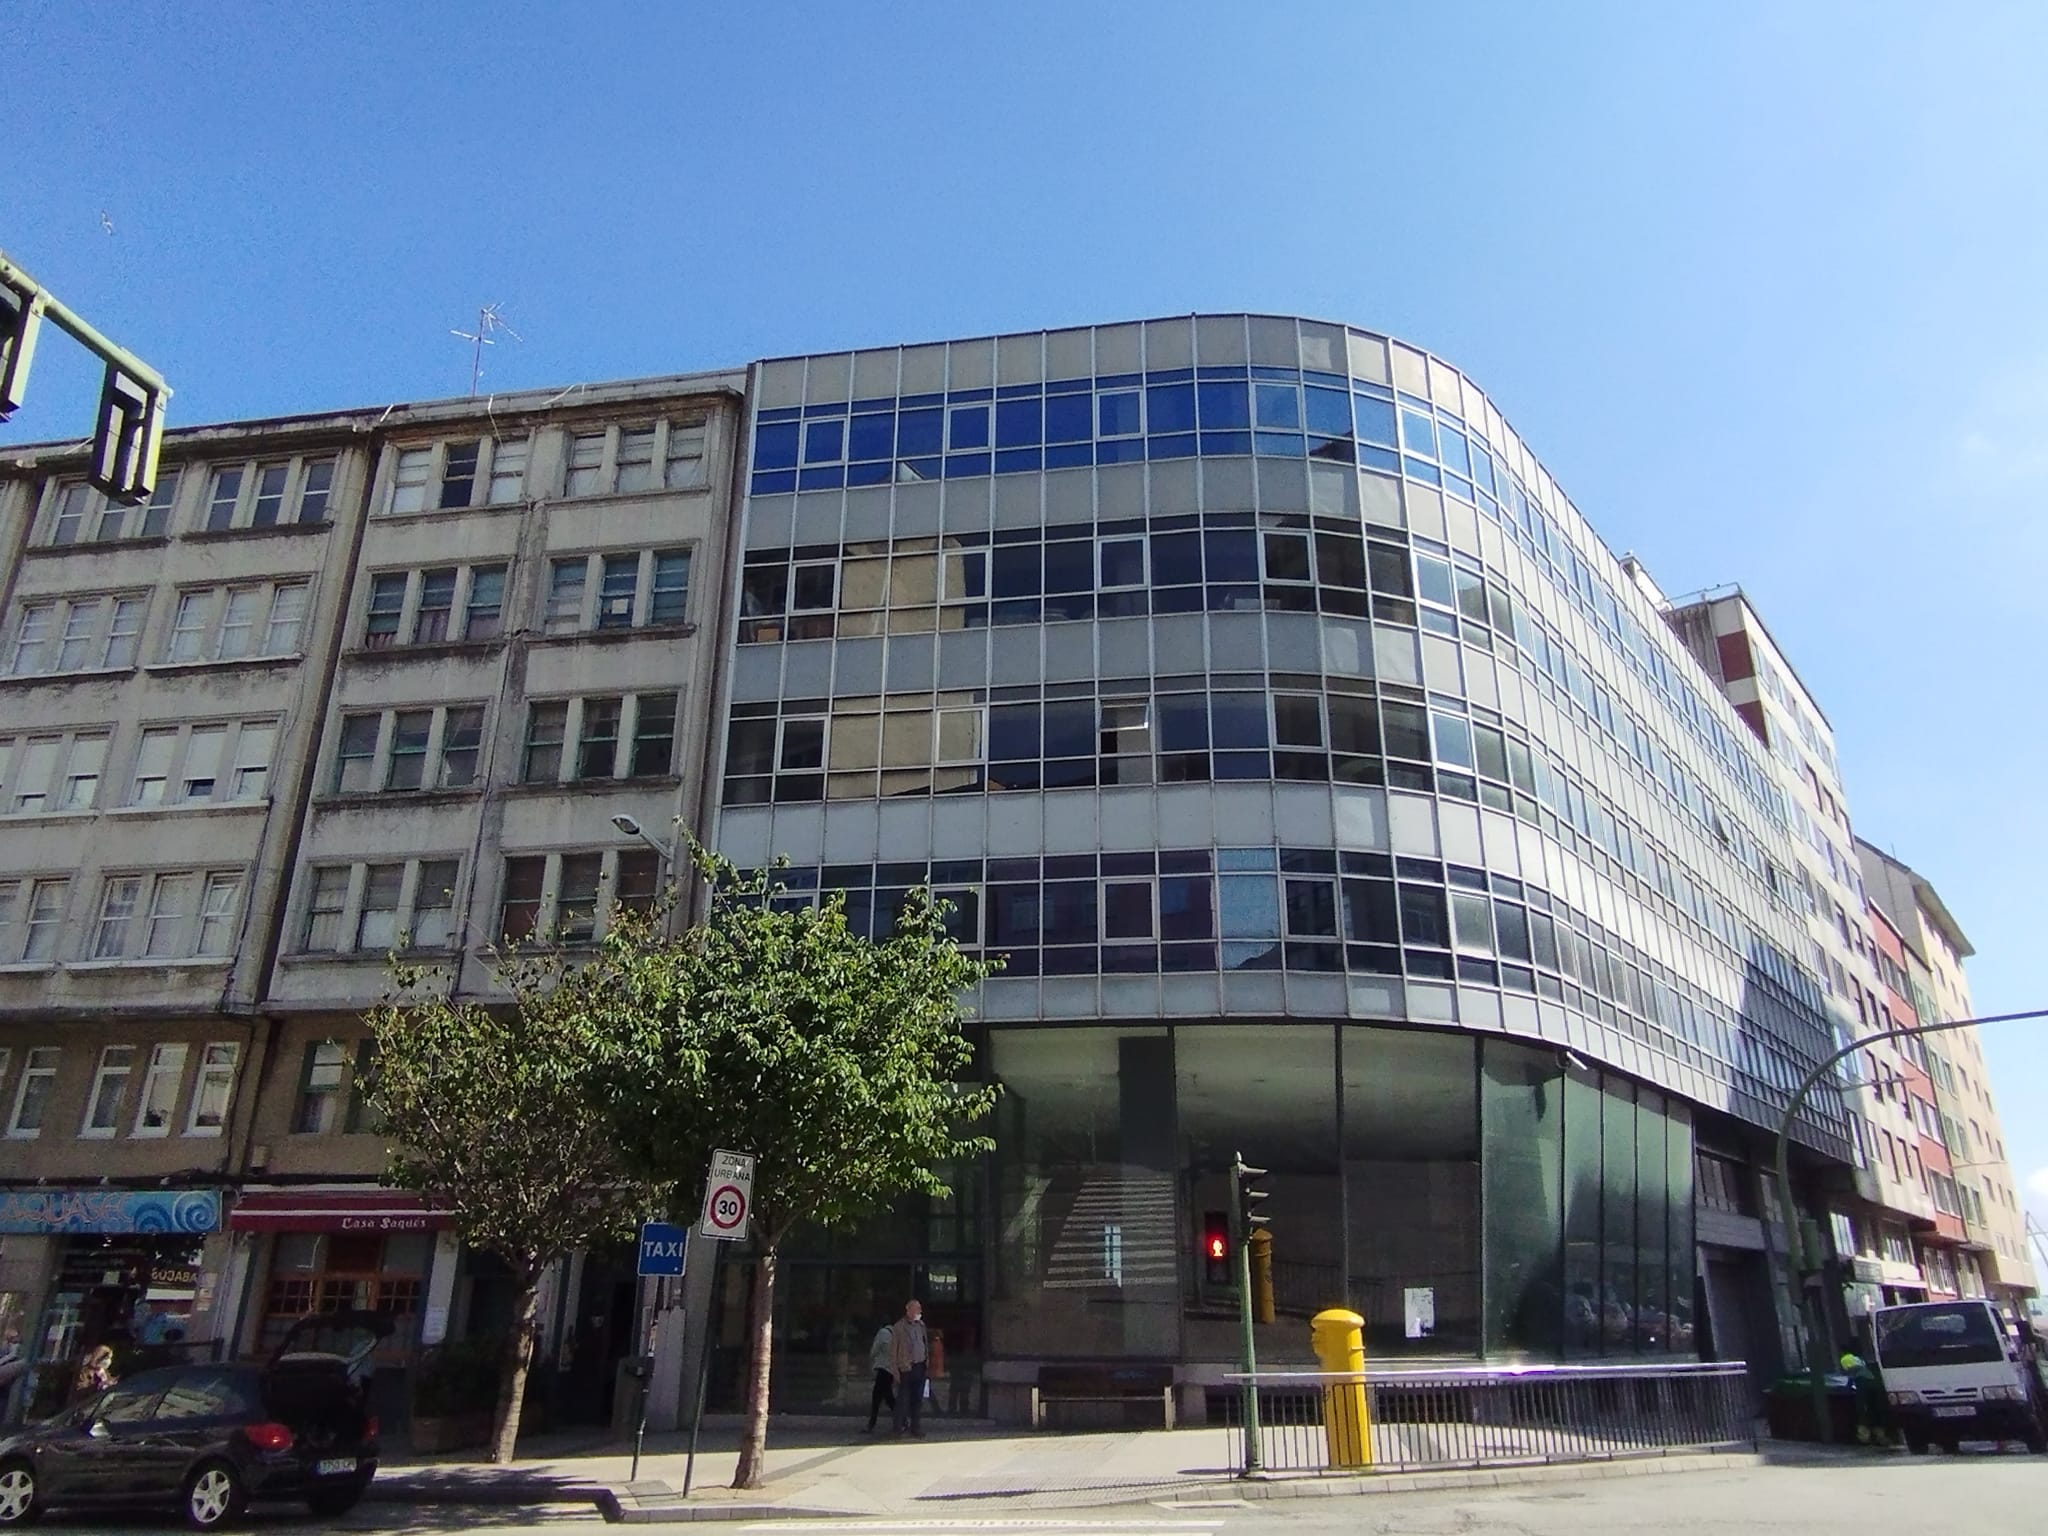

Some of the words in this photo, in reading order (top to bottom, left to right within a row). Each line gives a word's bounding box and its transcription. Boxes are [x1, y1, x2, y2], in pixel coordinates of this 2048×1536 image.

[721, 1155, 746, 1168] ZONA
[714, 1168, 750, 1181] URBANA
[719, 1200, 738, 1216] 30
[341, 1217, 375, 1229] Casa
[644, 1241, 684, 1257] TAXI
